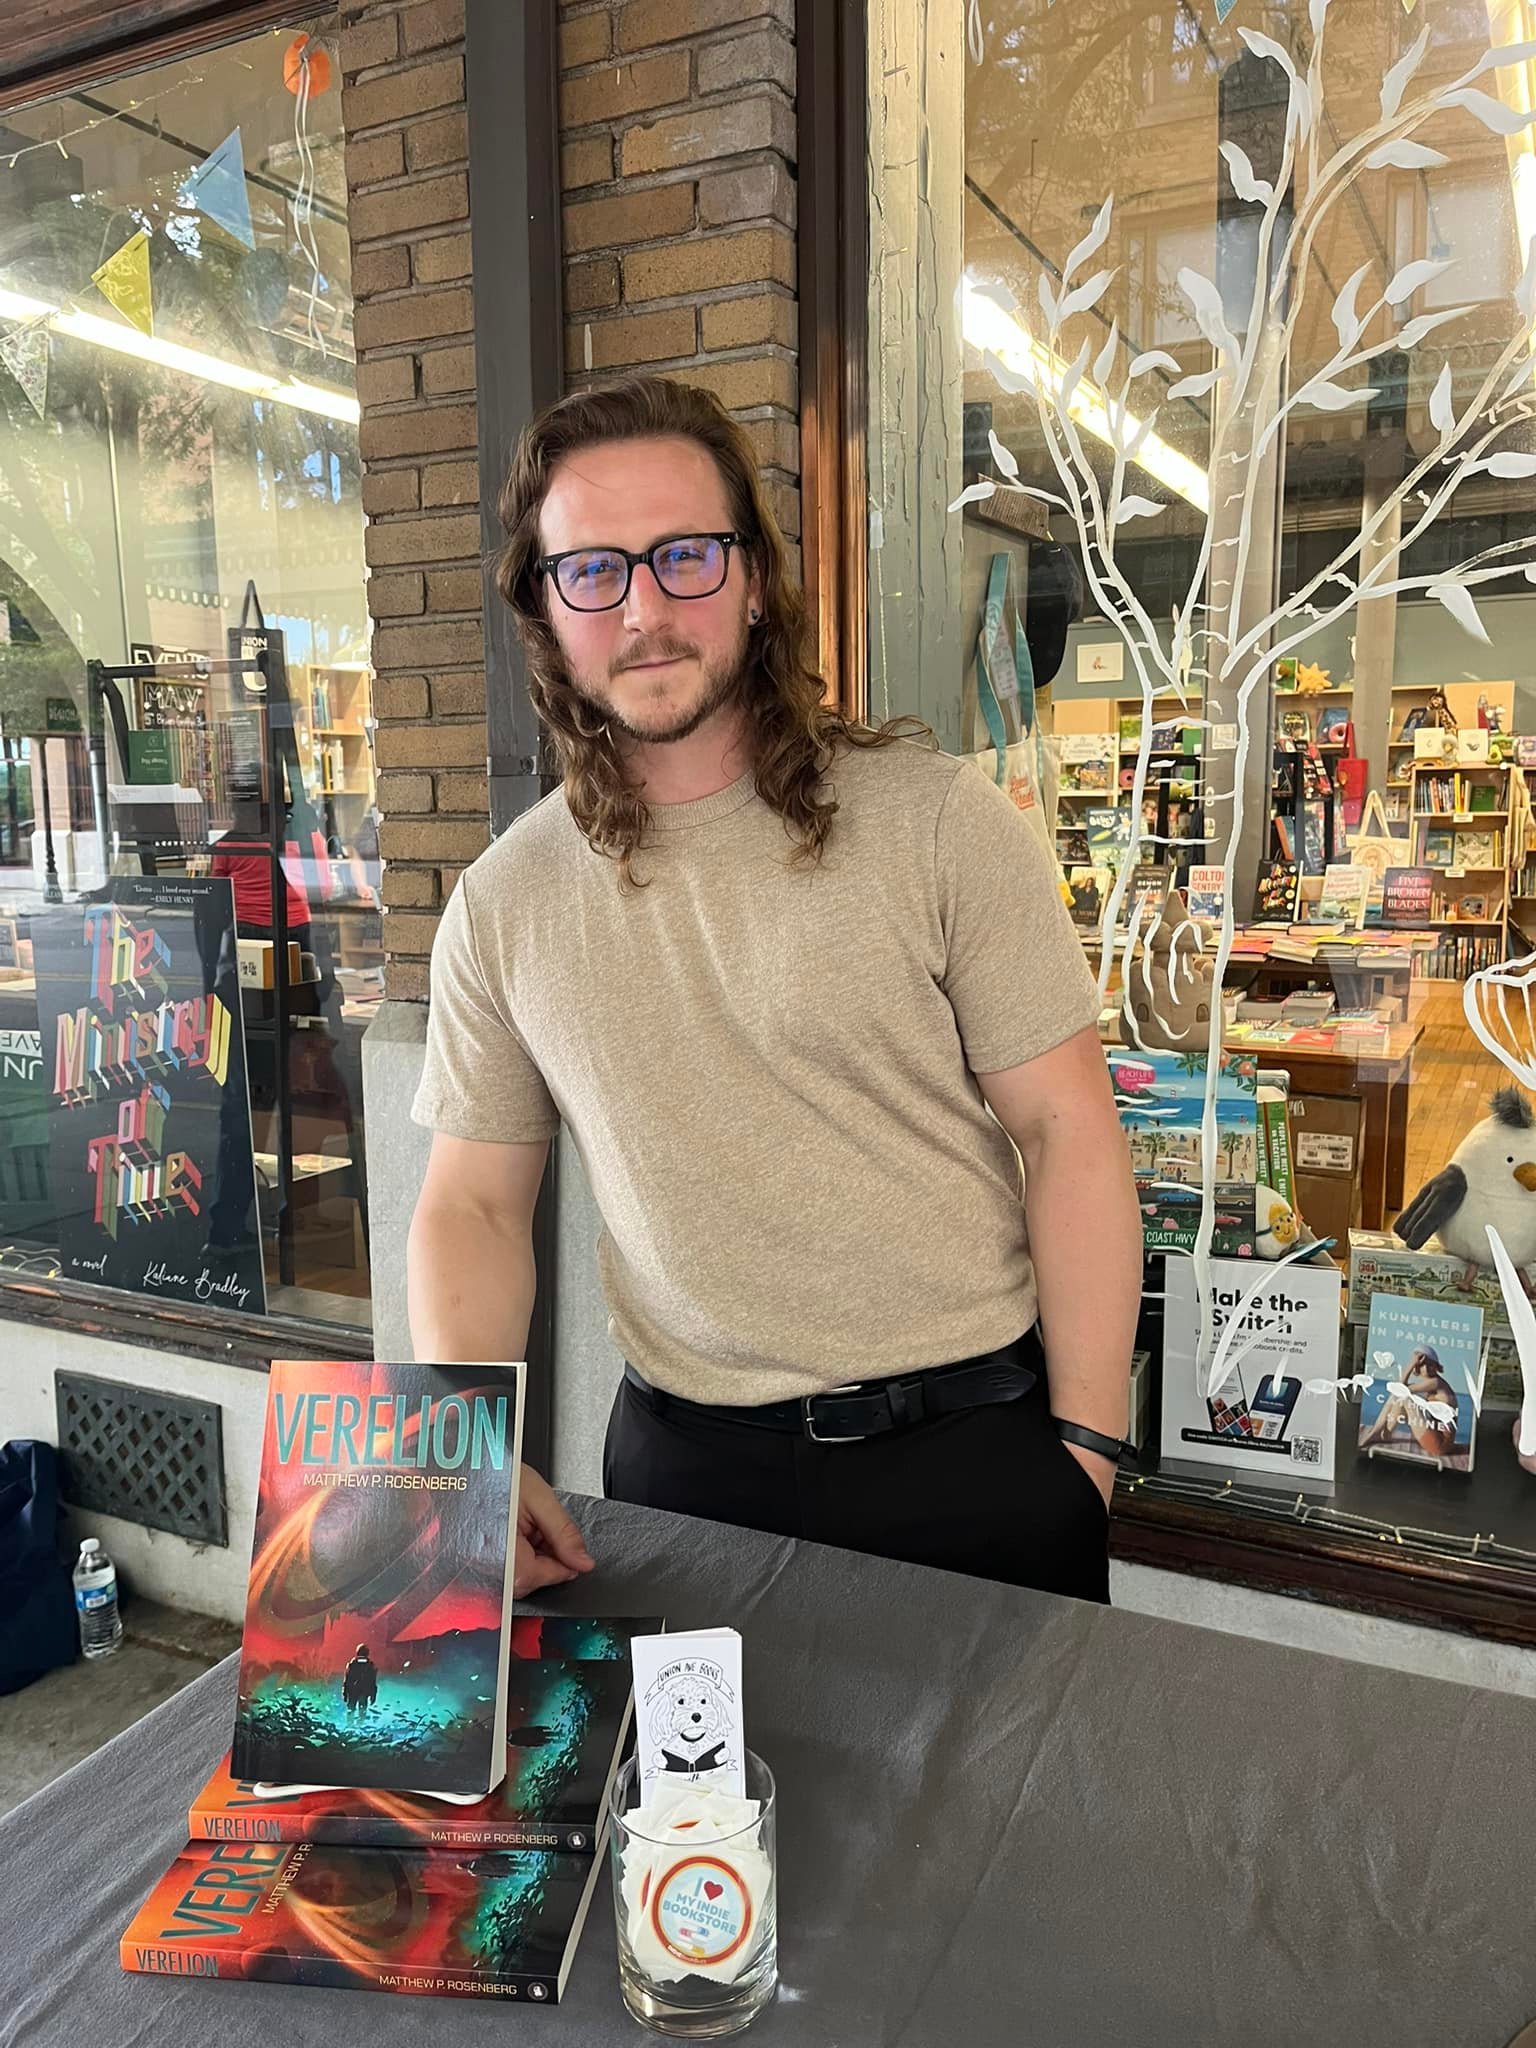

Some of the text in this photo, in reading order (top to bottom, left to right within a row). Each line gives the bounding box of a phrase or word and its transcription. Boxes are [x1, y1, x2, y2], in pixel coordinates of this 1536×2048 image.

[144, 685, 203, 712] MAY
[1387, 887, 1431, 897] BROKEN
[1398, 876, 1422, 886] FIVE
[1387, 899, 1428, 909] BLADES
[84, 901, 168, 1012] The
[53, 993, 231, 1108] Ministry
[88, 1134, 202, 1236] Time
[1146, 1231, 1196, 1244] COAST HWY
[82, 1254, 108, 1277] novel
[143, 1261, 250, 1307] Kaliane Bradley
[1268, 1293, 1308, 1313] the
[1379, 1310, 1471, 1333] KUNSTLERS
[1371, 1326, 1476, 1351] IN PARADISE
[275, 1393, 508, 1471] VERELION
[303, 1473, 468, 1491] MATTHEW P. ROSENBERG
[660, 1662, 682, 1682] UNION
[699, 1662, 720, 1681] BOOKS
[203, 1816, 281, 1842] VERELION
[431, 1831, 559, 1846] MATTHEW P. ROSENBERG
[261, 1859, 304, 1914] MATTHEW
[694, 1876, 704, 1897] I
[662, 1900, 738, 1936] BOOKSTORE
[676, 1892, 731, 1921] MY INDIE
[135, 1948, 219, 1978] VERELION
[379, 1975, 518, 1996] MATTHEW P. ROSENBERG
